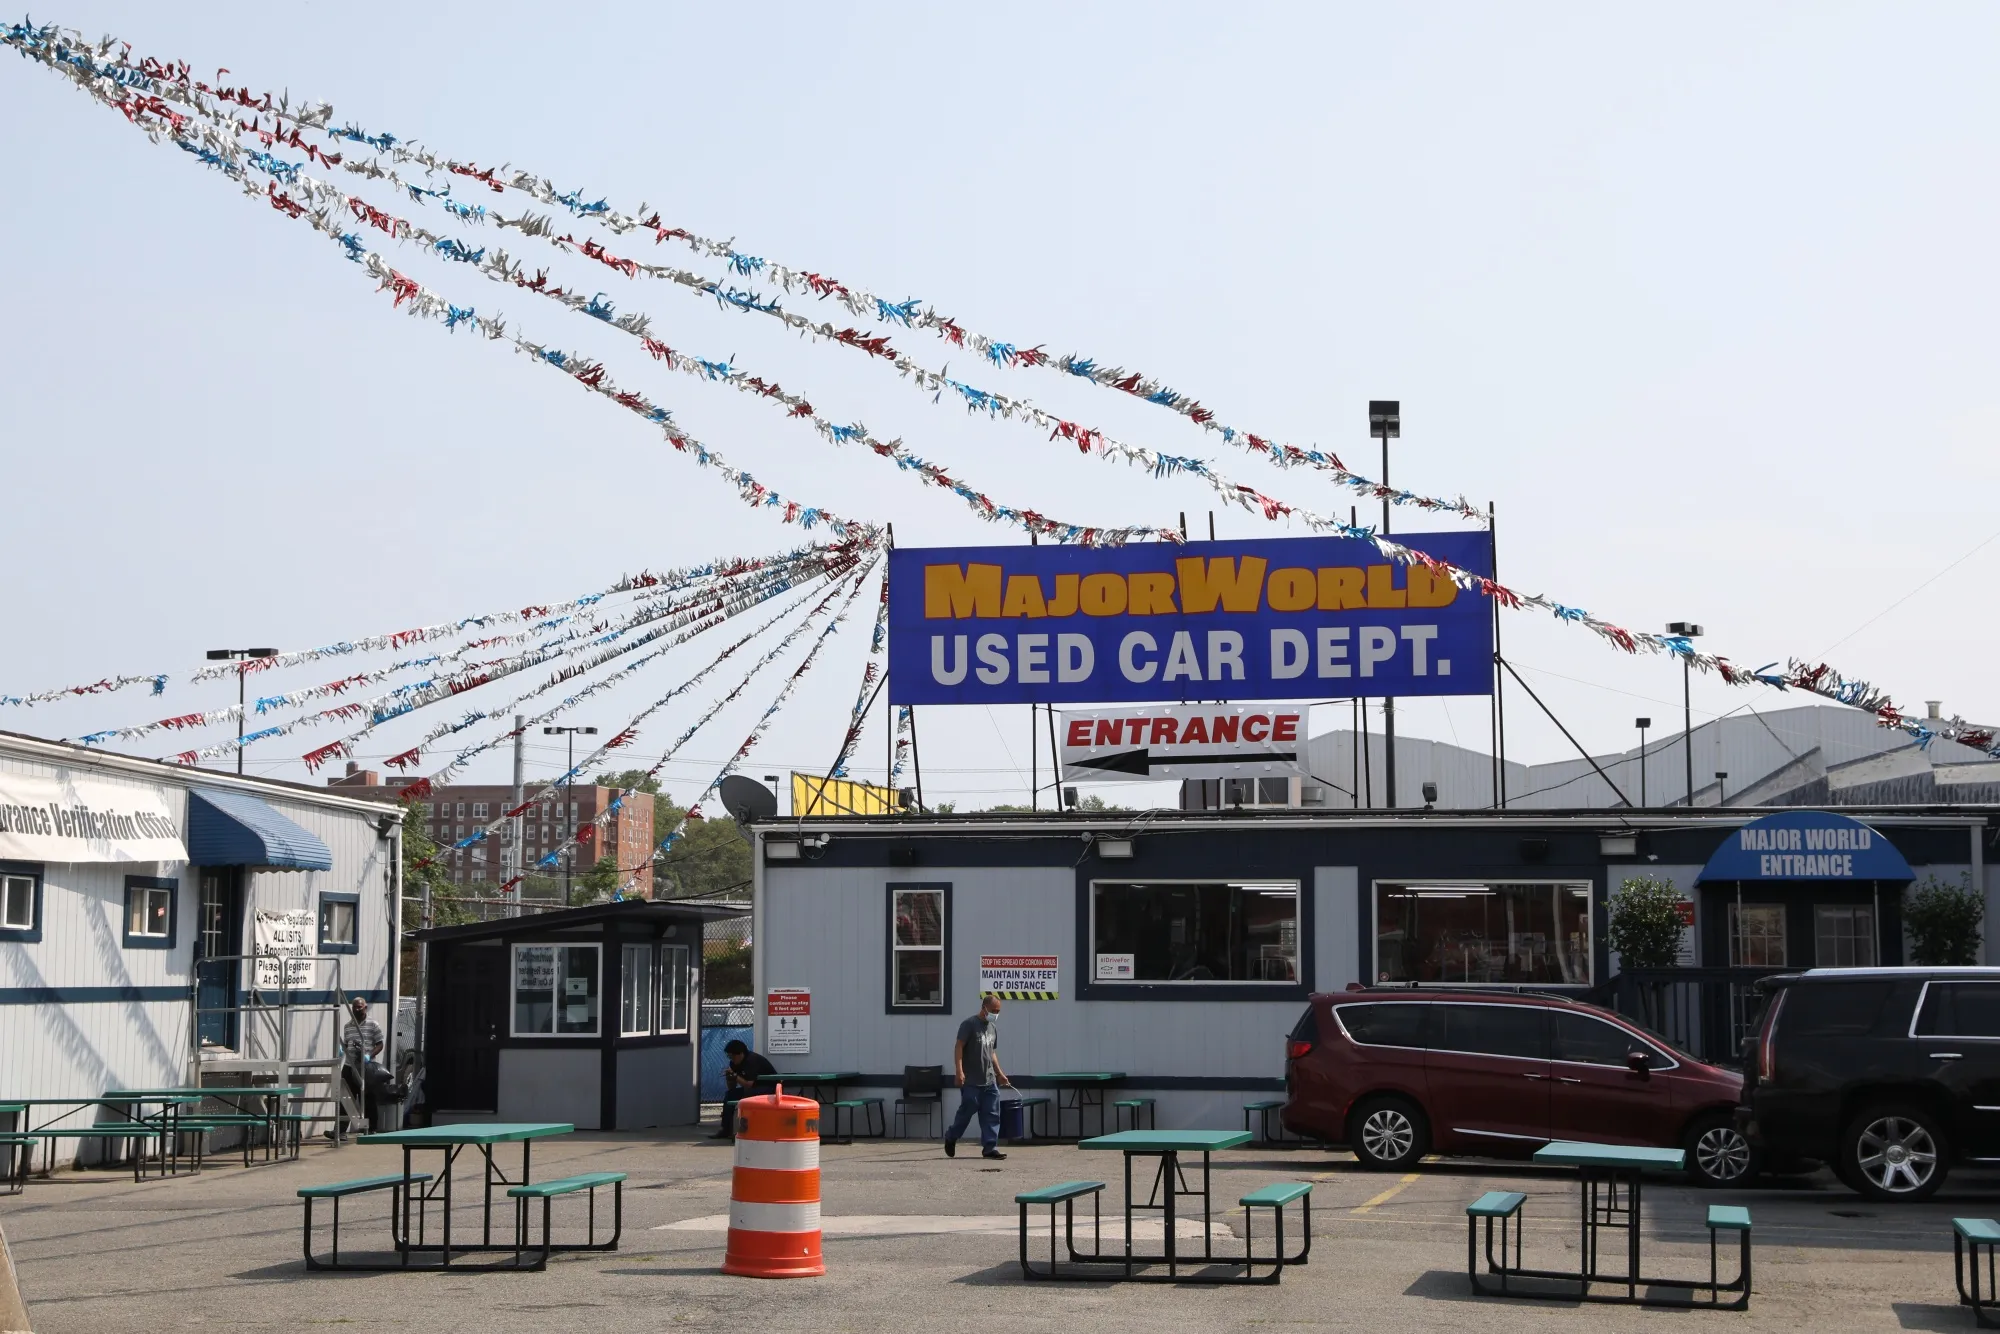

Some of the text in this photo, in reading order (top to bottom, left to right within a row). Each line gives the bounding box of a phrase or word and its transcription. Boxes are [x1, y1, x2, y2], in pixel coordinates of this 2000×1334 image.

[931, 624, 1451, 685] USED CAR DEPT.
[1066, 714, 1300, 746] ENTRANCE
[49, 803, 141, 840] Verification
[134, 810, 180, 840] Offic
[1740, 828, 1871, 850] MAJOR WORLD
[1760, 854, 1853, 876] ENTRANCE
[273, 930, 285, 943] ALL
[286, 960, 312, 974] egister
[982, 958, 993, 966] STOP
[993, 958, 1002, 966] THE
[1002, 958, 1018, 966] SPREAD
[1019, 958, 1025, 966] OF
[1025, 958, 1043, 966] CORONA
[982, 970, 1057, 979] MAINTAIN SIX FEET
[993, 981, 1046, 990] OF DISTANCE
